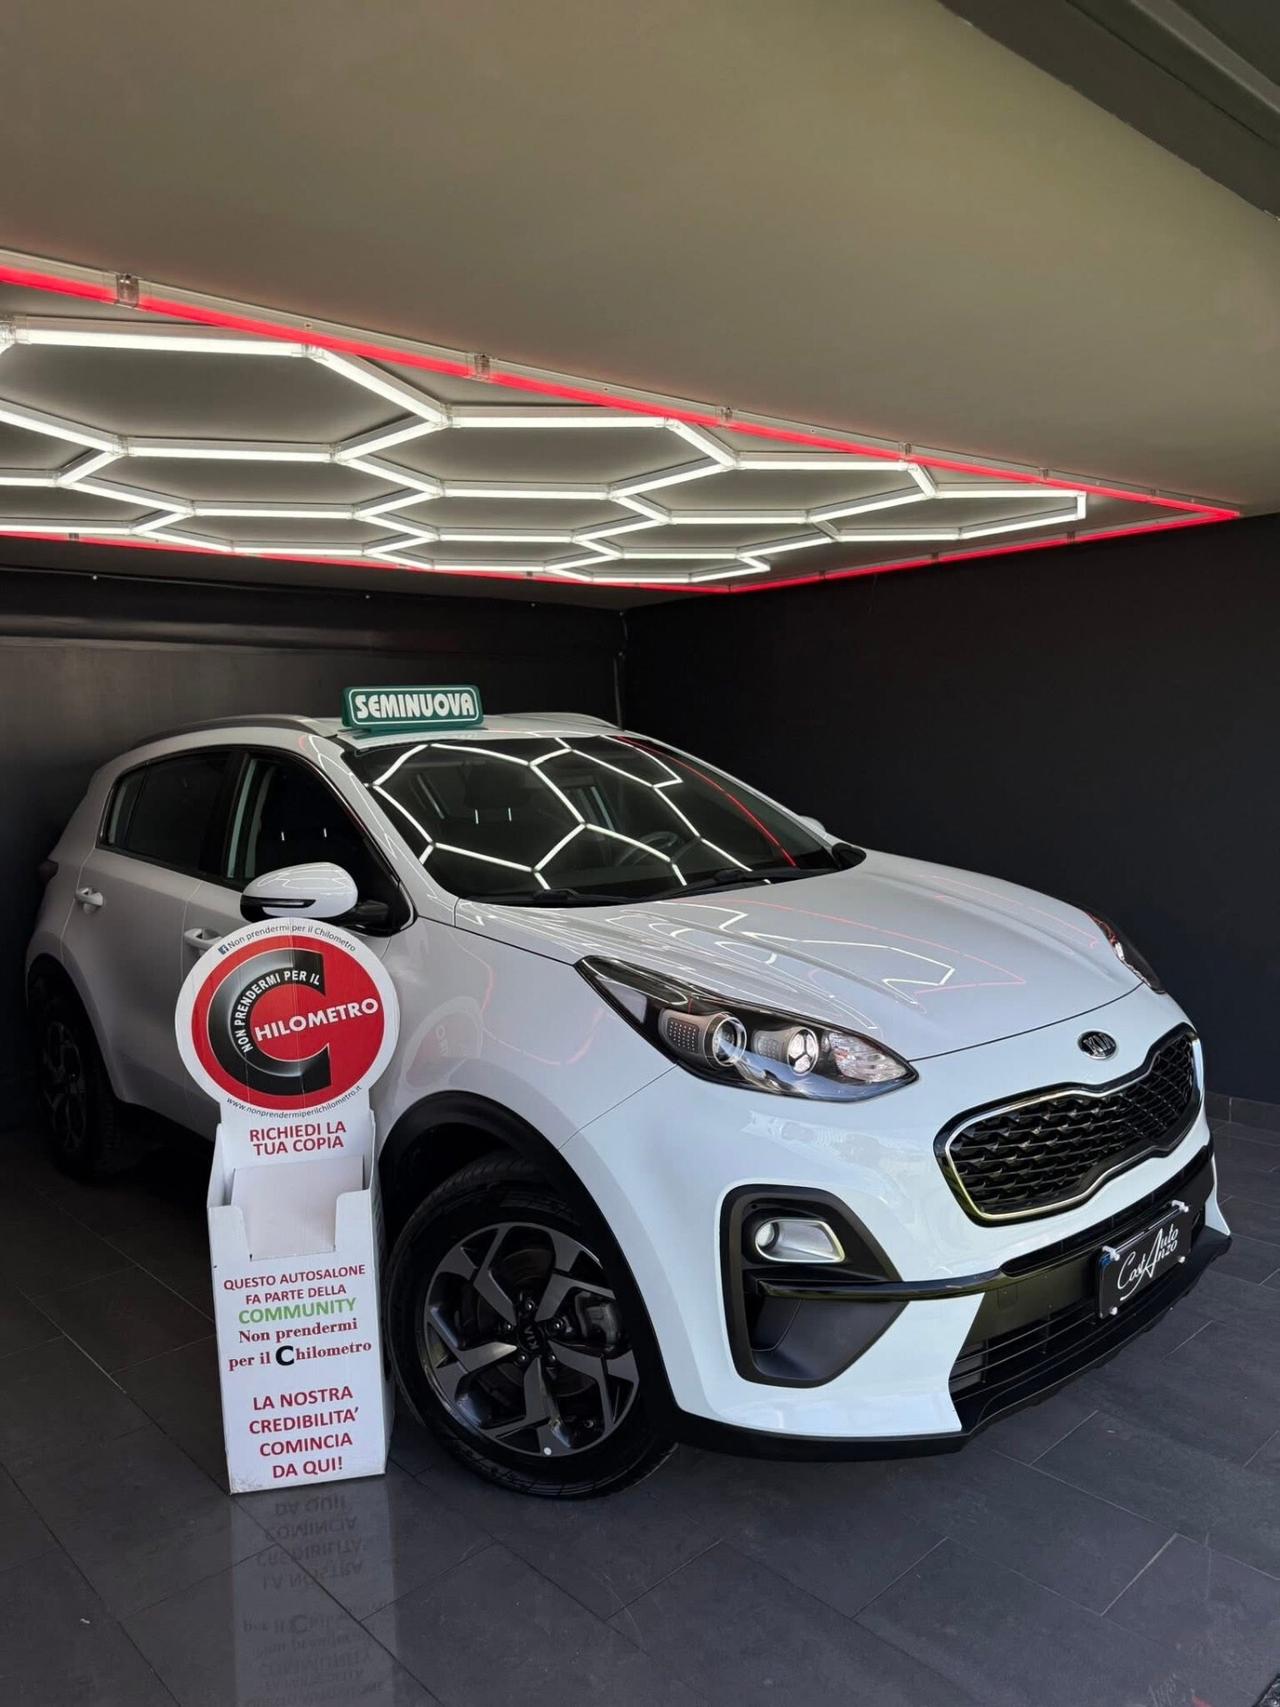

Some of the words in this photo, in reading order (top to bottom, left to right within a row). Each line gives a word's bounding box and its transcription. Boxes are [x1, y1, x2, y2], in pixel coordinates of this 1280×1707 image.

[354, 692, 475, 719] SEMINUOVA
[227, 934, 244, 949] Non
[246, 924, 290, 942] prendermi
[292, 924, 306, 933] per
[307, 924, 313, 933] il
[314, 926, 356, 952] Chilometro
[283, 970, 307, 981] PER
[310, 973, 321, 986] IL
[234, 972, 281, 1026] PRENDERMI
[234, 1030, 254, 1053] NON
[249, 1124, 322, 1143] RICHIEDI
[326, 1121, 347, 1134] LA
[253, 1142, 289, 1156] TUA
[293, 1136, 344, 1153] COPIA
[223, 1275, 277, 1291] QUESTO
[279, 1264, 366, 1285] AUTOSALONE
[245, 1294, 262, 1305] FA
[264, 1288, 304, 1303] PARTE
[307, 1284, 347, 1297] DELLA
[238, 1297, 357, 1324] COMMUNITY
[238, 1330, 271, 1344] Non
[275, 1317, 359, 1343] prendermi
[228, 1356, 256, 1371] per
[259, 1353, 271, 1365] il
[275, 1341, 372, 1366] Chilometro
[252, 1396, 275, 1411] LA
[279, 1385, 354, 1408] NOSTRA
[259, 1432, 354, 1457] COMINCIA
[272, 1464, 298, 1479] DA
[302, 1456, 343, 1475] QUI!
